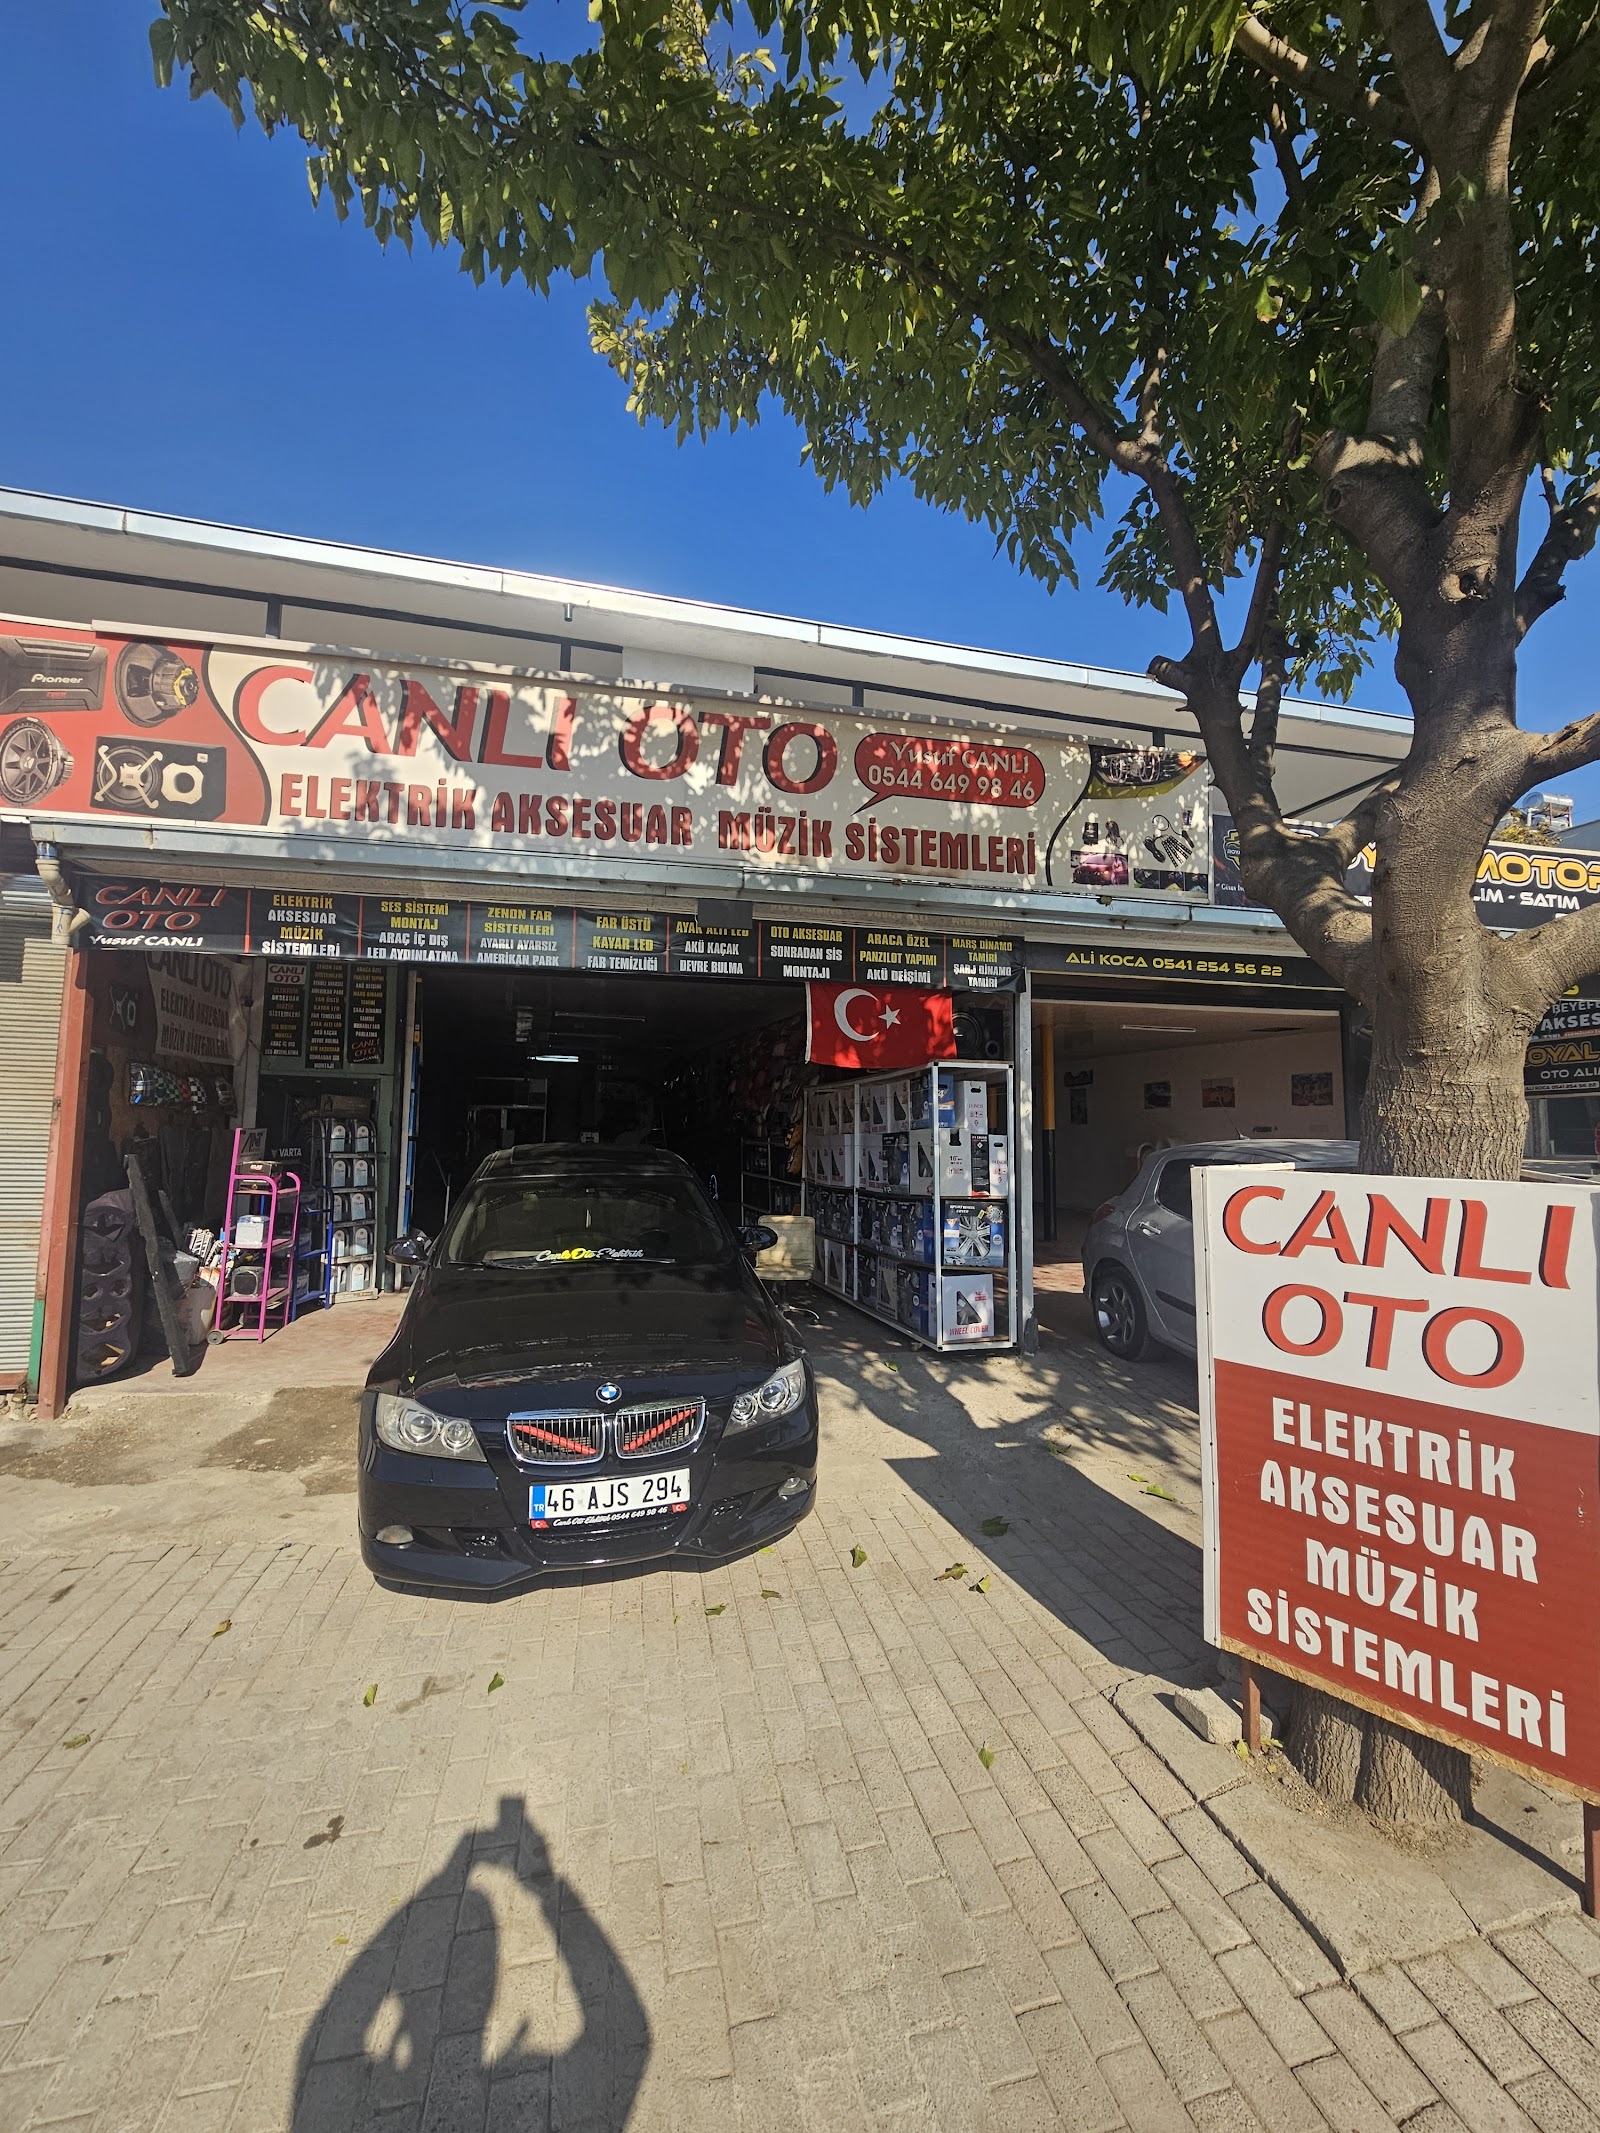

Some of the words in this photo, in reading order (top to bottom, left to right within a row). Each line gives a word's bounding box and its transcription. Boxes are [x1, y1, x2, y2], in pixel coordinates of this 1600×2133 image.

[31, 673, 83, 684] Pioneer
[233, 665, 577, 772] CANLI
[619, 705, 838, 794] OTO
[890, 741, 955, 765] Yusuf
[962, 749, 1029, 774] CANLI
[868, 765, 923, 789] 0544
[930, 772, 969, 794] 649
[977, 777, 1002, 798] 98
[1009, 780, 1035, 800] 46
[280, 772, 476, 831] ELEKTRİK
[491, 791, 693, 846] AKSESUAR
[719, 807, 832, 859] MÜZİK
[845, 817, 1036, 875] SİSTEMLERİ
[95, 885, 228, 907] CANLI
[273, 894, 333, 909] ELEKTRİK
[1520, 891, 1580, 910] SATIM
[381, 900, 402, 913] SES
[405, 901, 449, 916] SİSTEMİ
[488, 907, 526, 920] ZENON
[530, 909, 552, 922] FAR
[102, 909, 201, 931] OTO
[268, 909, 337, 925] AKSESUAR
[390, 916, 439, 930] MONTAJ
[596, 916, 618, 930] FAR
[621, 916, 651, 932] ÜSTÜ
[280, 925, 324, 941] MÜZİK
[484, 921, 555, 937] SİSTEMLERİ
[770, 926, 789, 939] OTO
[792, 926, 843, 943] AKSESUAR
[90, 934, 144, 947] Yusuf
[144, 936, 204, 947] CANLI
[379, 931, 410, 945] ARAÇ
[413, 931, 426, 947] İÇ
[429, 934, 449, 948] DIŞ
[480, 937, 514, 950] AYARLI
[517, 939, 558, 952] AYARSIZ
[592, 935, 630, 951] KAYAR
[633, 938, 654, 952] LED
[867, 933, 903, 947] ARACA
[906, 933, 930, 948] ÖZEL
[952, 938, 977, 951] MARŞ
[981, 938, 1013, 952] DİNAMO
[261, 939, 341, 957] SİSTEMLERİ
[366, 946, 387, 960] LED
[390, 947, 459, 963] AYDINLATMA
[685, 939, 705, 954] AKÜ
[707, 941, 740, 957] KAÇAK
[770, 945, 823, 960] SONRADAN
[826, 946, 843, 962] SİS
[477, 950, 530, 966] AMERİKAN
[533, 954, 559, 967] PARK
[588, 955, 607, 969] FAR
[609, 956, 658, 972] TEMİZLİĞİ
[905, 952, 937, 967] YAPIMI
[968, 951, 998, 964] TAMİRİ
[1066, 951, 1095, 965] ALİ
[1099, 954, 1148, 968] KOCA
[1152, 957, 1193, 971] 0541
[1196, 961, 1231, 973] 254
[1234, 963, 1256, 975] 56
[1260, 965, 1283, 977] 22
[270, 965, 304, 975] CANLI
[680, 959, 709, 973] DEVRE
[711, 960, 744, 975] BULMA
[783, 965, 830, 979] MONTAJI
[866, 968, 888, 981] AKÜ
[953, 963, 977, 975] ŞARJ
[274, 974, 300, 983] OTO
[967, 976, 998, 988] TAMİRİ
[1527, 1043, 1600, 1066] OYAL
[1540, 1069, 1569, 1079] OTO
[279, 1147, 302, 1158] VARTA
[1222, 1185, 1576, 1290] CANLI
[949, 1327, 968, 1336] WHEEL
[970, 1324, 989, 1334] COVER
[1262, 1283, 1525, 1389] OTO
[1272, 1397, 1516, 1501] ELEKTRİK
[547, 1488, 575, 1513] 46
[588, 1482, 629, 1511] AJS
[643, 1474, 682, 1504] 294
[534, 1503, 545, 1512] TR
[611, 1512, 630, 1521] 0544
[631, 1510, 645, 1518] 649
[658, 1506, 668, 1514] 46
[1260, 1459, 1539, 1584] AKSESUAR
[1306, 1537, 1480, 1642] MÜZİK
[1247, 1588, 1567, 1757] SİSTEMLERİ
